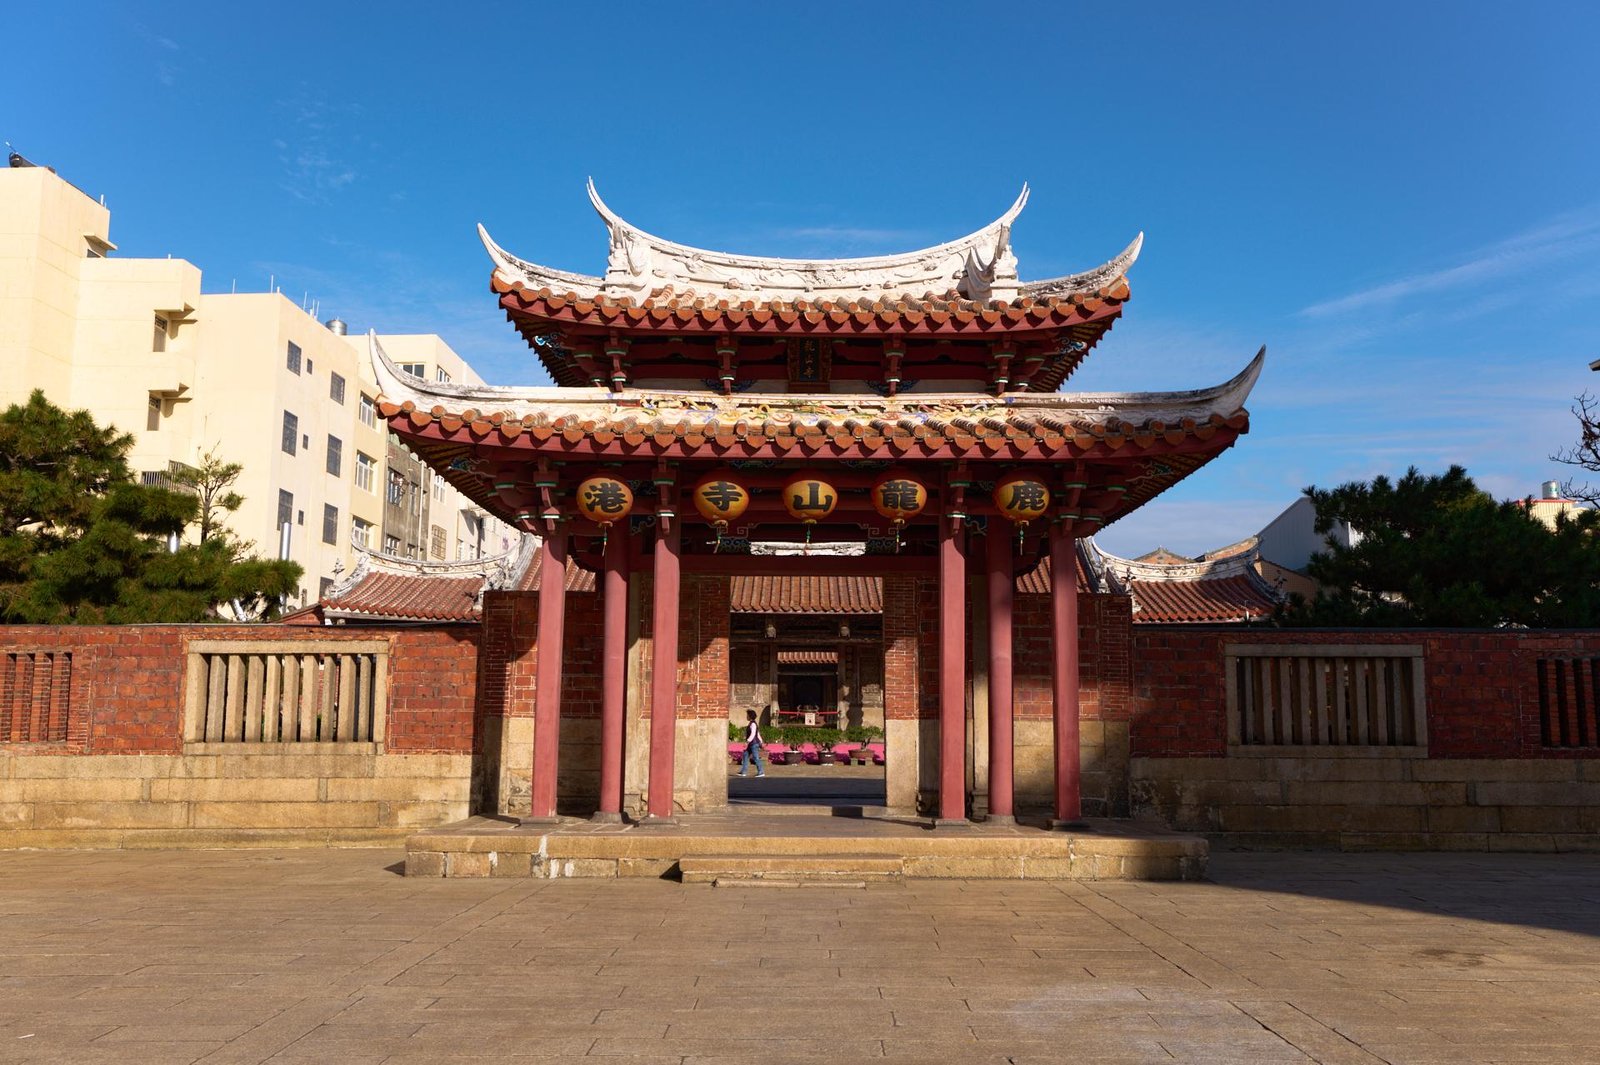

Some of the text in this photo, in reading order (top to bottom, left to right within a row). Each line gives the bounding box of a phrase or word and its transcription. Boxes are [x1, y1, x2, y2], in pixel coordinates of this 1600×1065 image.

[584, 482, 628, 513] 港
[702, 481, 743, 511] 寺
[793, 483, 833, 512] 山
[880, 480, 919, 511] 龍
[1006, 481, 1046, 510] 鹿
